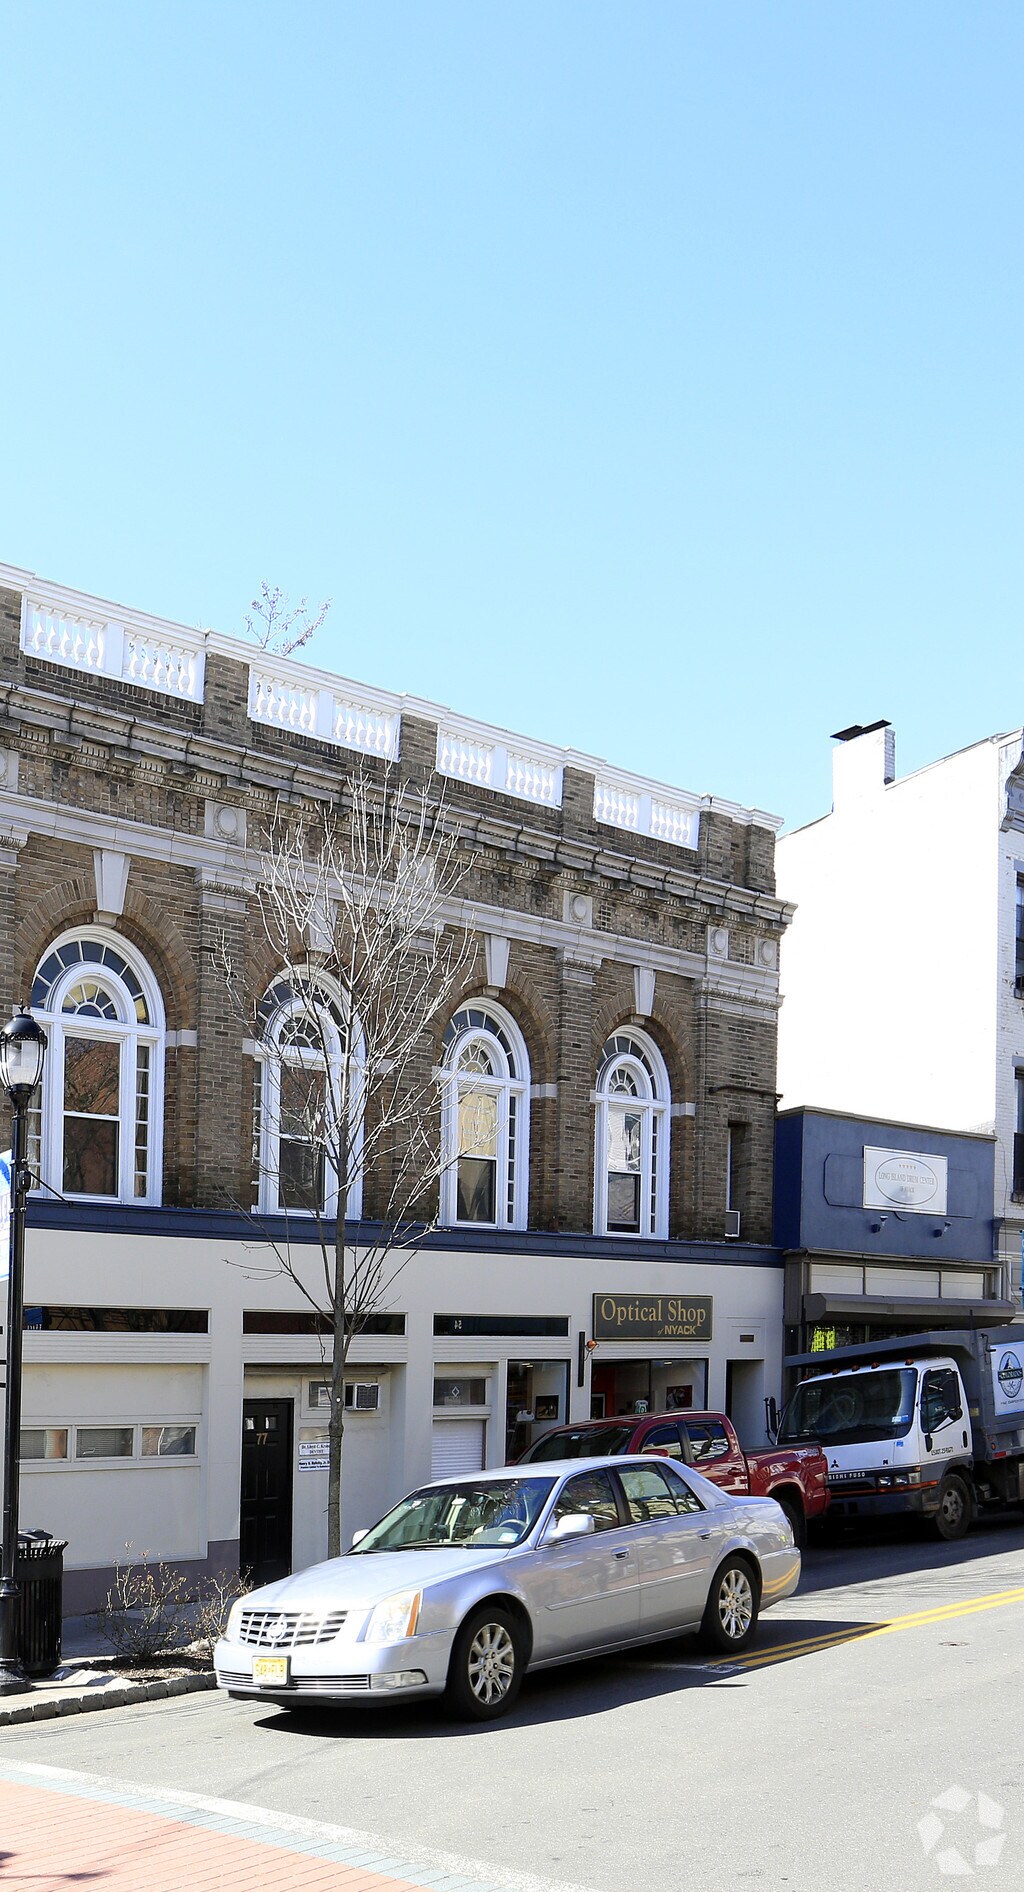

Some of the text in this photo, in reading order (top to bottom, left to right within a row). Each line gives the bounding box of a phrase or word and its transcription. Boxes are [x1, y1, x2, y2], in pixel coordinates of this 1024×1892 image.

[878, 1171, 890, 1180] LONG
[601, 1298, 706, 1327] Optical Shop
[657, 1325, 696, 1336] of NYACK
[256, 1433, 268, 1445] 77
